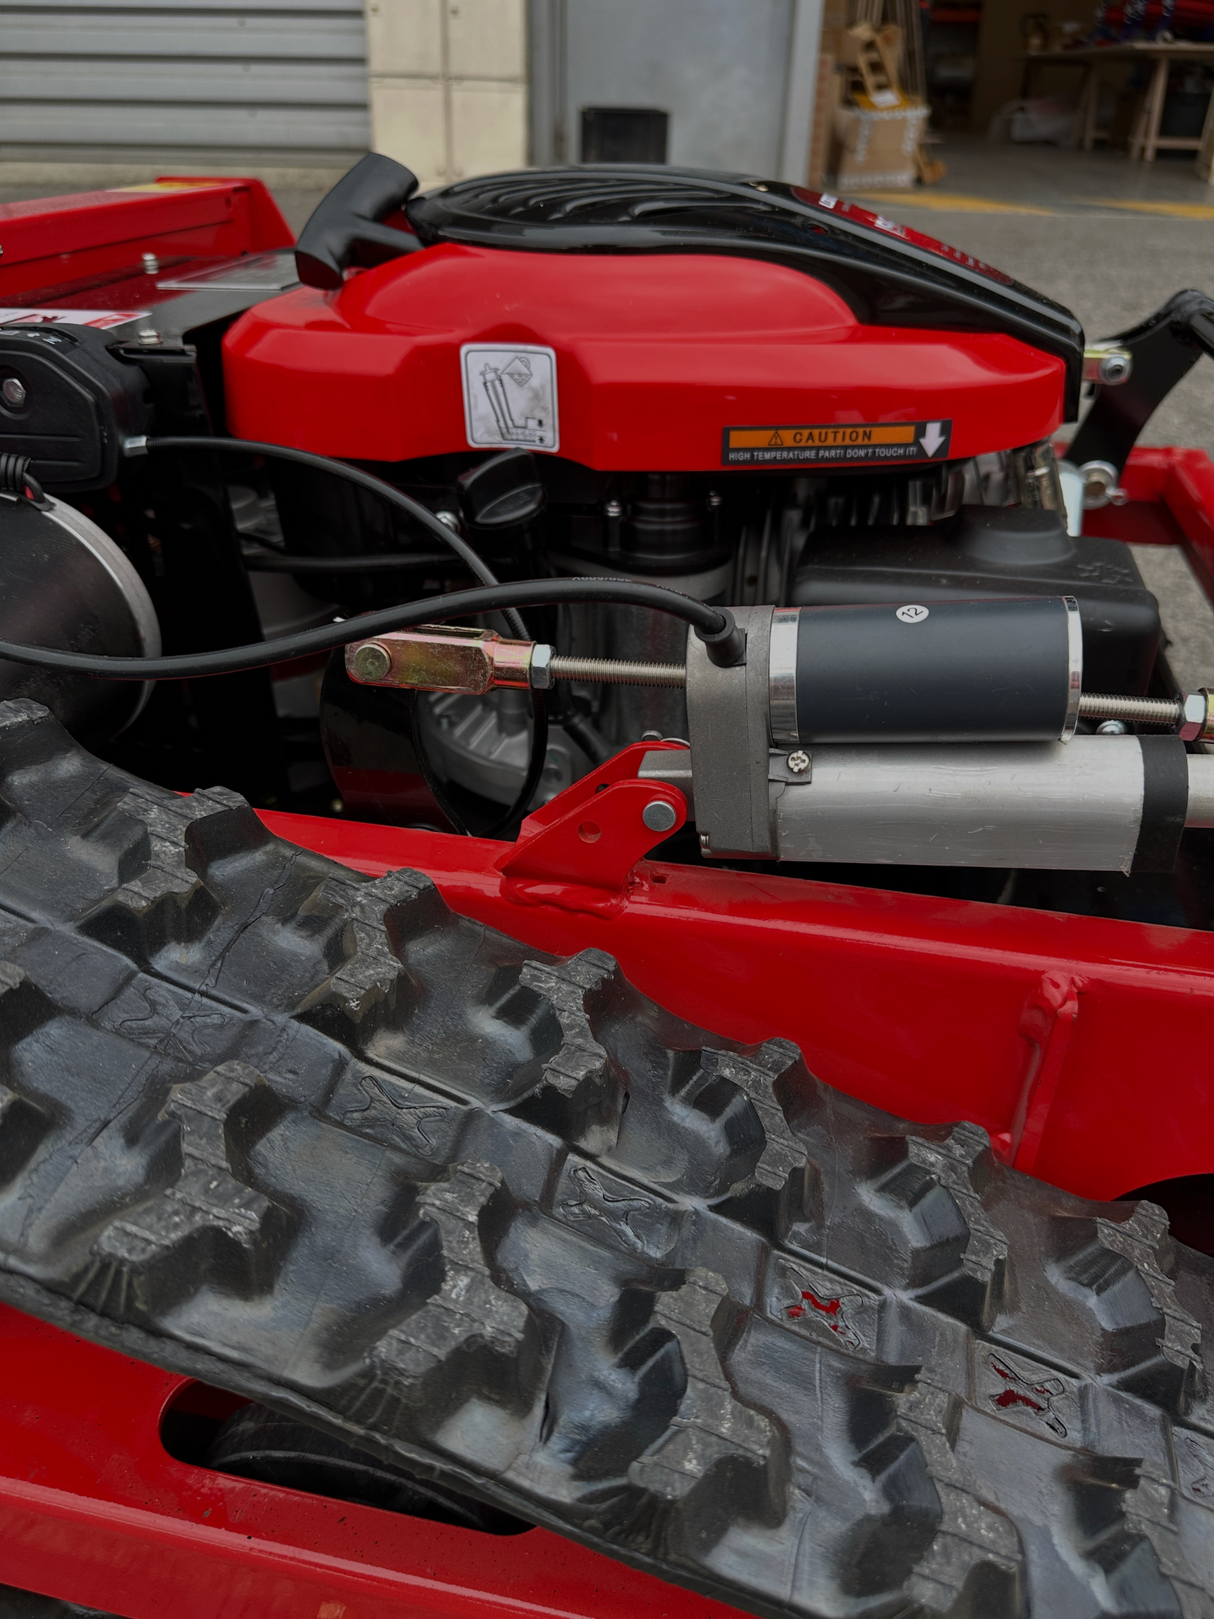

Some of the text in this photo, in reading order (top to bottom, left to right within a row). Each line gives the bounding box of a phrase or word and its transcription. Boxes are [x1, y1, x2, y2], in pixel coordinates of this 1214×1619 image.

[793, 429, 872, 443] CAUTION
[728, 451, 751, 462] HIGH
[753, 449, 817, 461] TEMPERATURE
[846, 447, 872, 459] DON'T
[875, 446, 904, 458] TOUCH
[901, 607, 924, 619] 12
